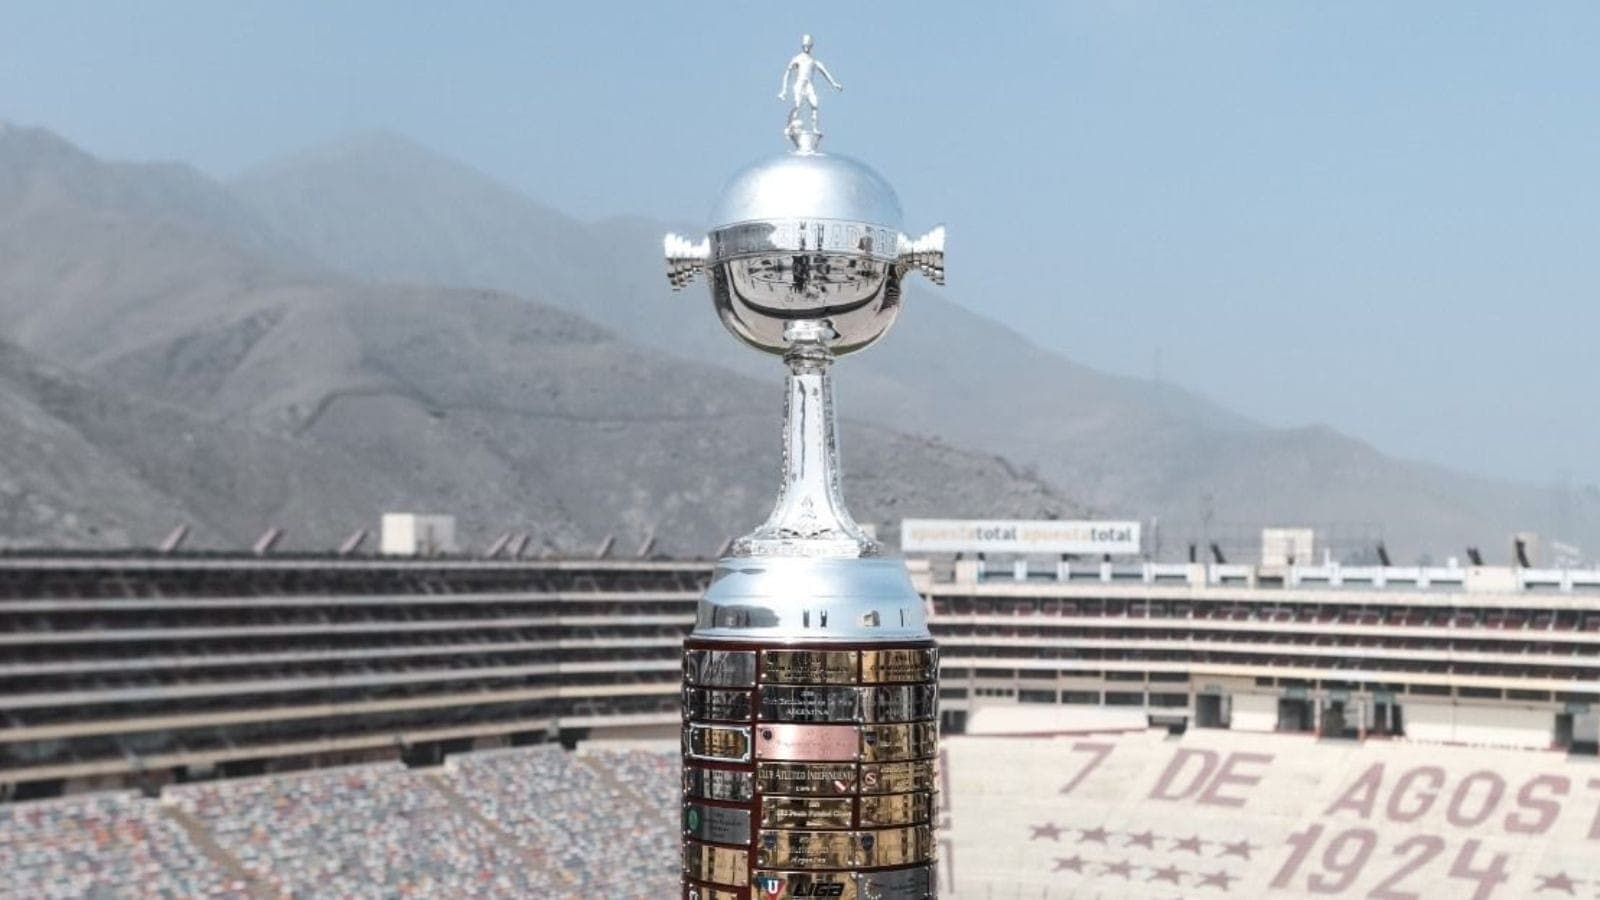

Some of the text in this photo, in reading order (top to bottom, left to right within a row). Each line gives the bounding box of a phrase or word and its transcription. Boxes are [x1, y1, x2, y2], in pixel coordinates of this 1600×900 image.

[1059, 743, 1600, 840] 7 DE AGOS
[1268, 823, 1510, 900] 1924
